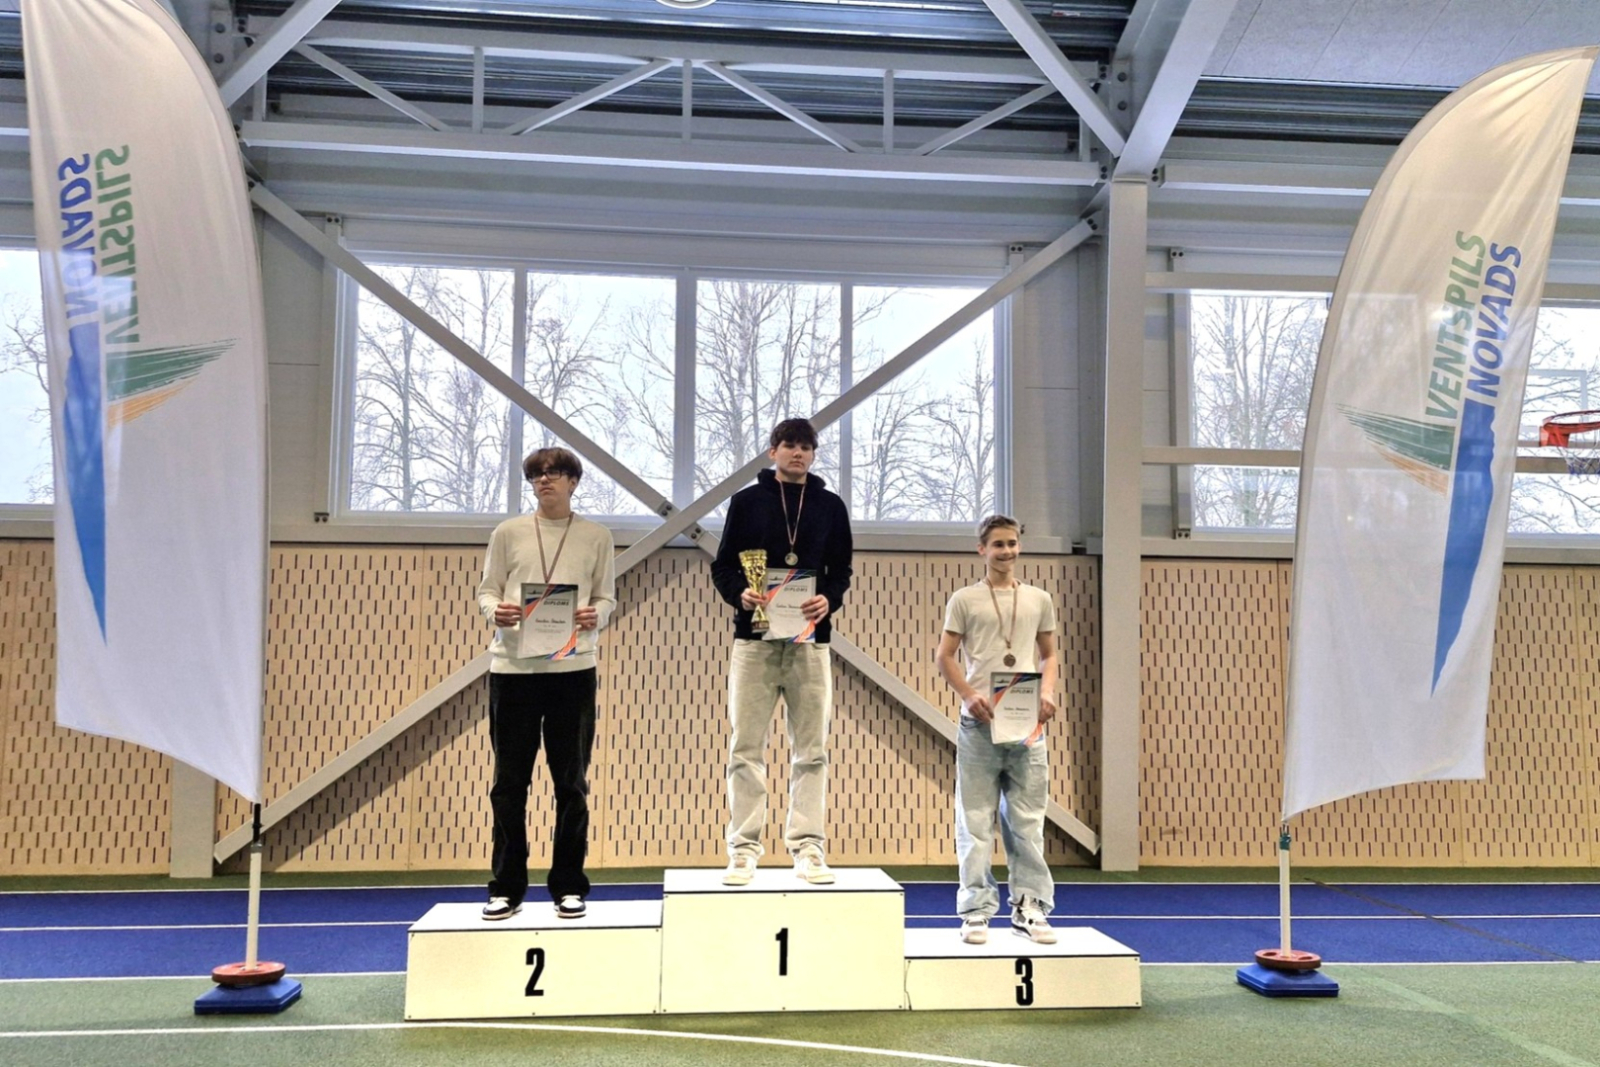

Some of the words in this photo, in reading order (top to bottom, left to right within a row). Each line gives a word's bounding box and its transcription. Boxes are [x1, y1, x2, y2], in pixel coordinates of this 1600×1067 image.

[1425, 230, 1487, 419] VENTSPILS
[1465, 242, 1522, 398] NOVADS
[525, 947, 545, 997] 2
[775, 927, 789, 976] 1
[1015, 957, 1034, 1006] 3
